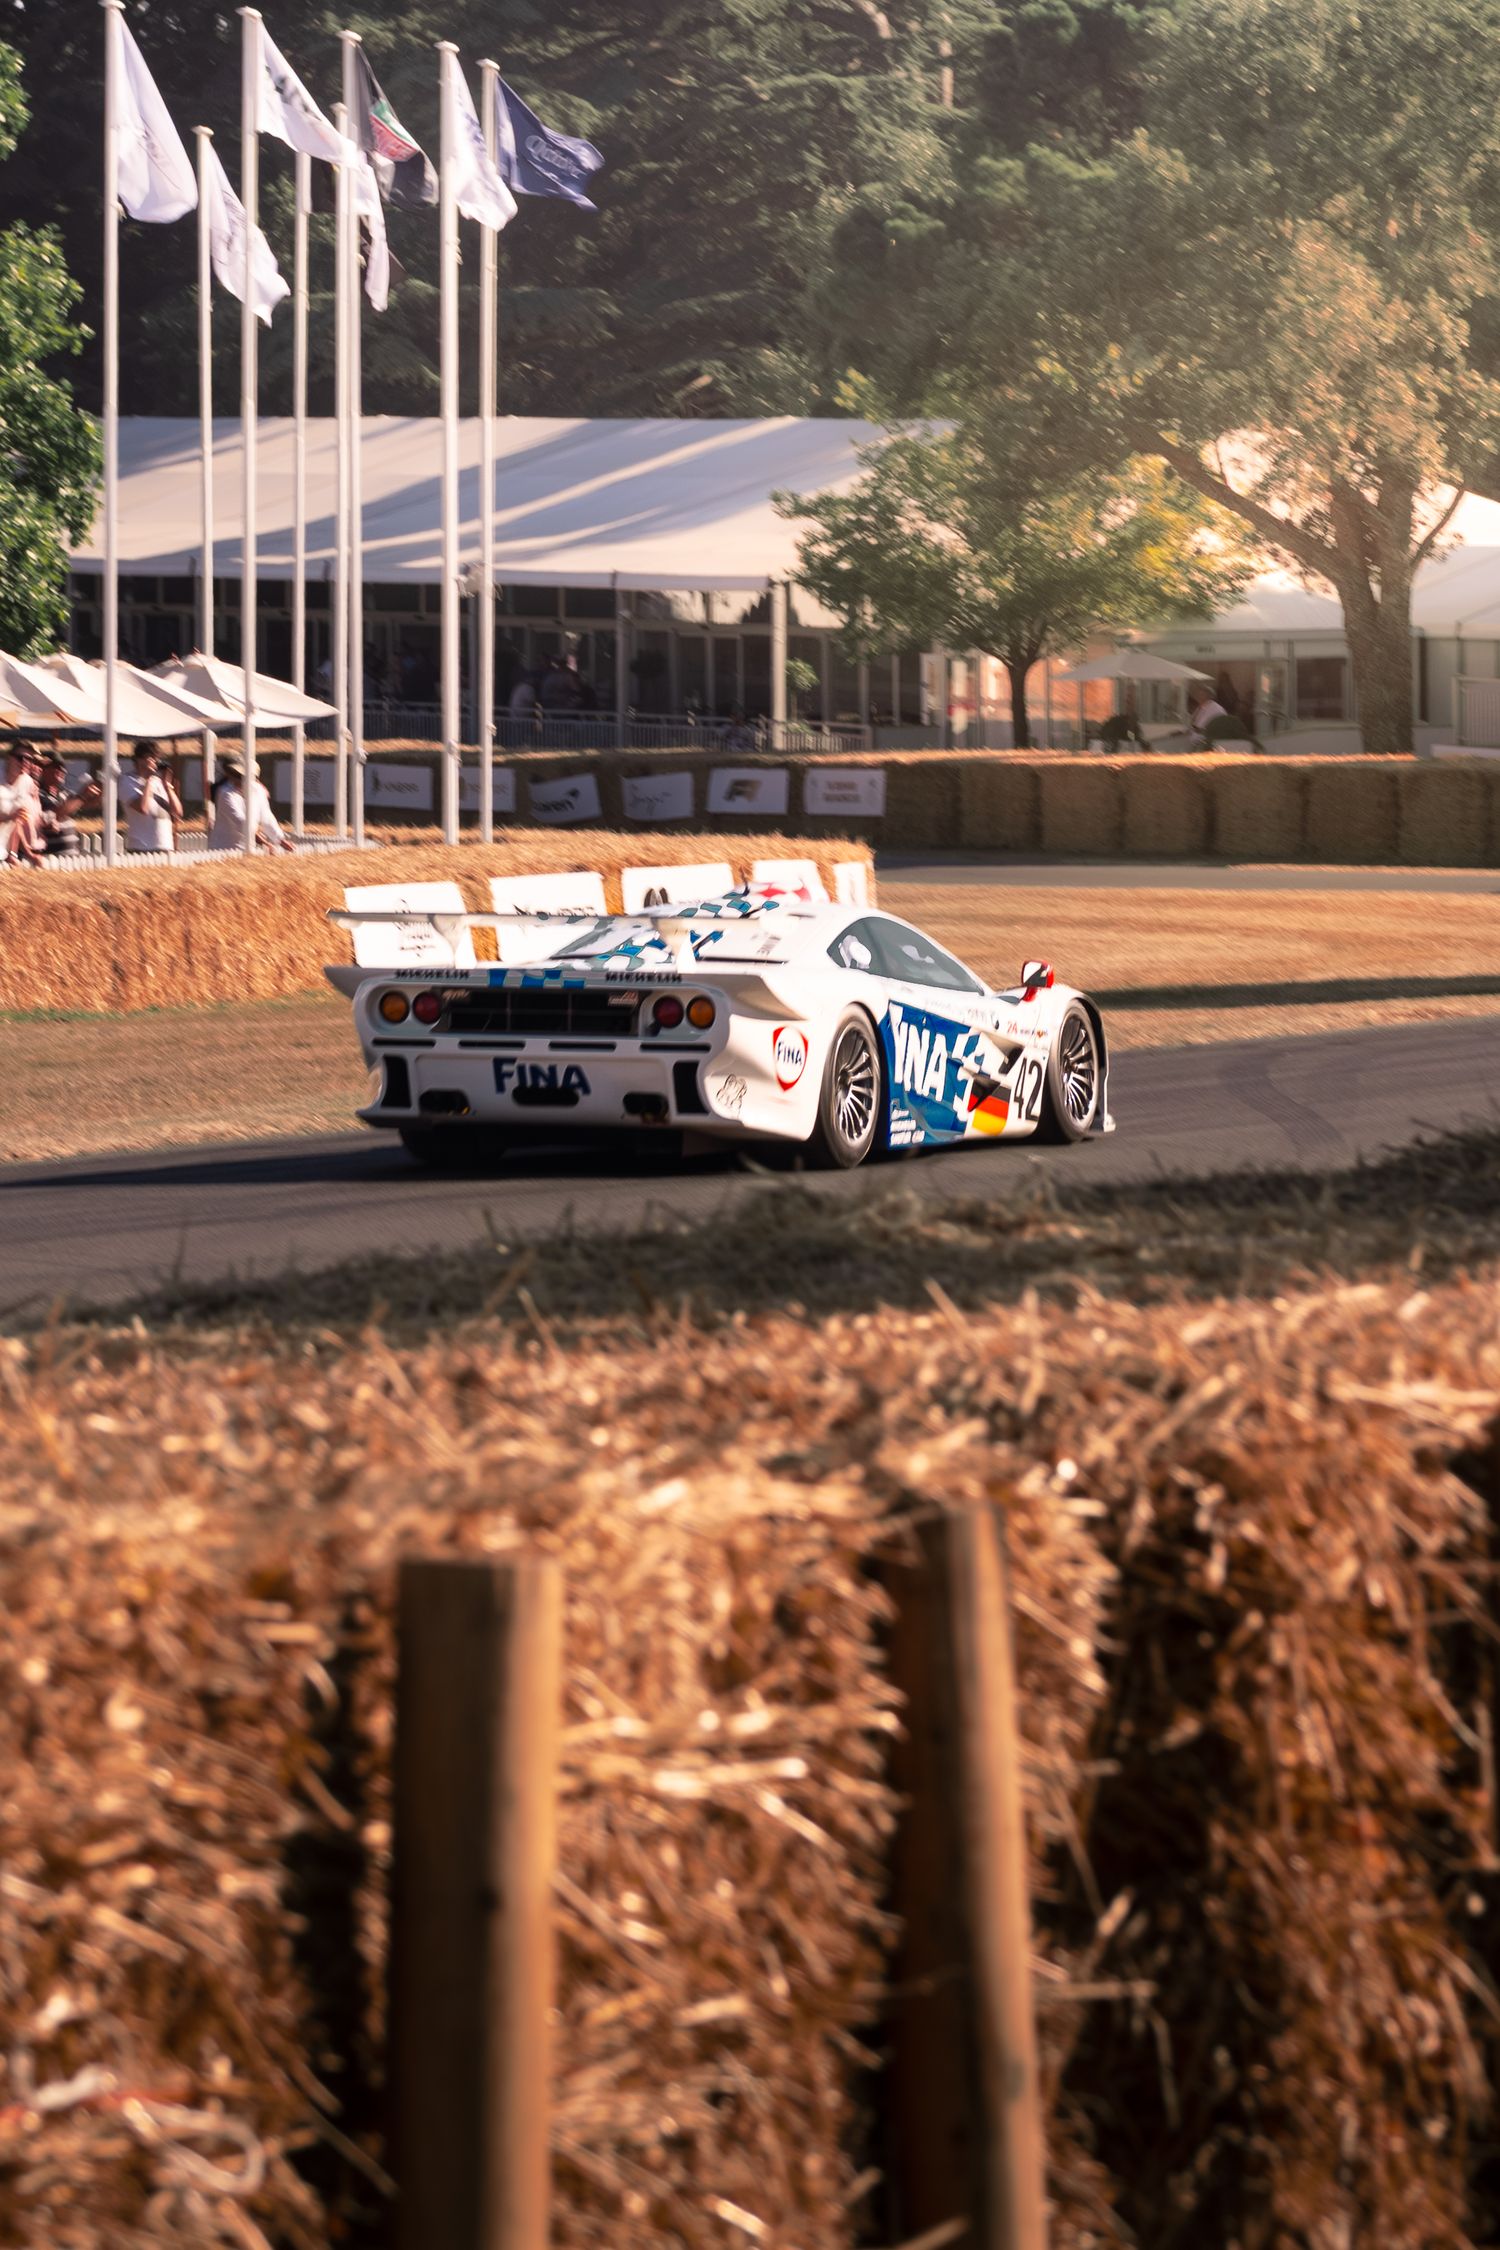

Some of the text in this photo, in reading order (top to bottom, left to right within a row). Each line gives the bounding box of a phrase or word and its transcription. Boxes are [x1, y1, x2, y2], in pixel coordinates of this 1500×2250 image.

[395, 969, 470, 979] MICHELIN
[605, 972, 682, 983] MICHELIN
[777, 1041, 802, 1066] FINA
[492, 1057, 591, 1096] FINA
[1013, 1057, 1043, 1121] 42
